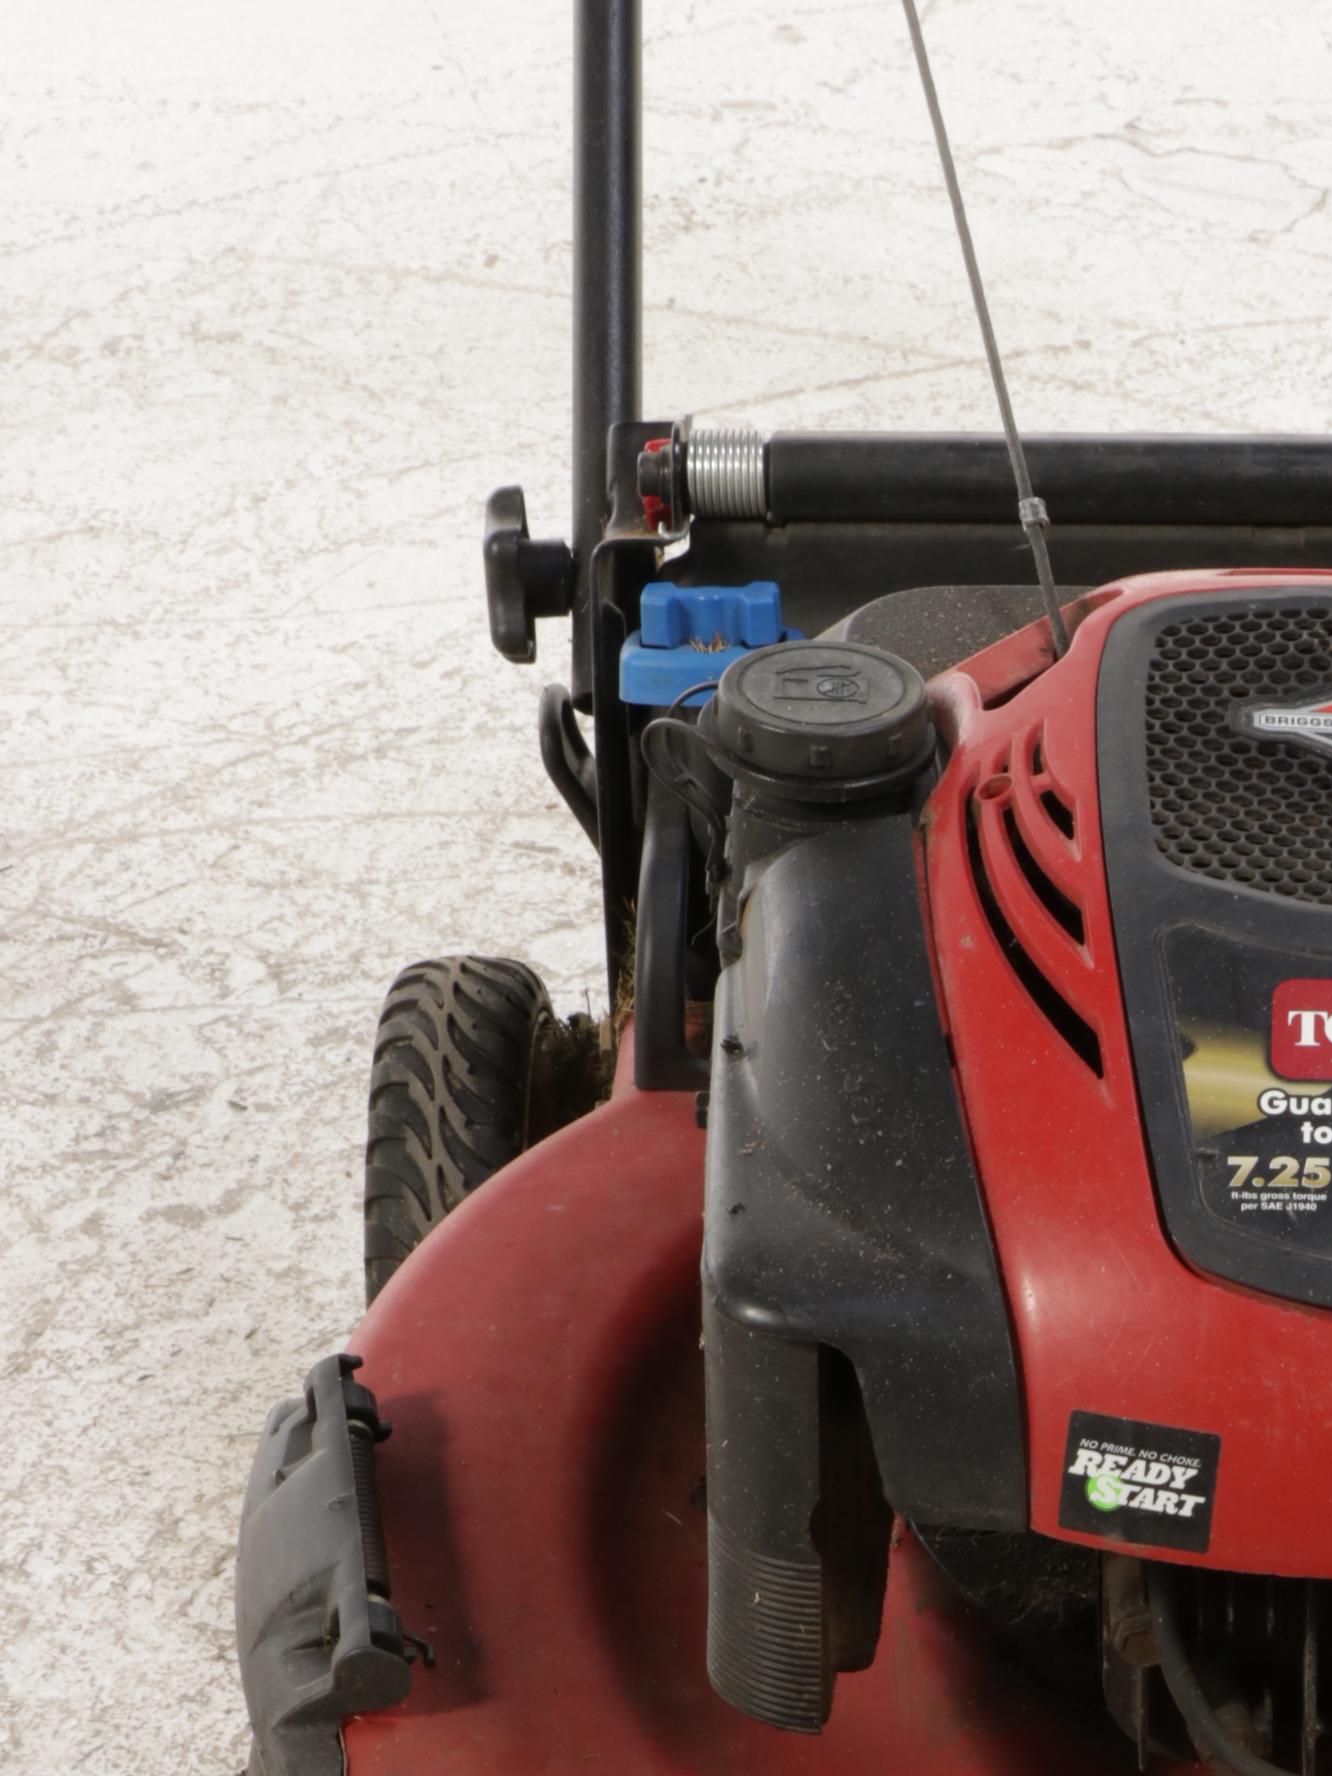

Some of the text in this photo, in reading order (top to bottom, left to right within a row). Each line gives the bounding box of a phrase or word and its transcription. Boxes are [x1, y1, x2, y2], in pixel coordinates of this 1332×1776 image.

[1227, 1156, 1332, 1189] 7.25
[1240, 1203, 1259, 1212] per
[1260, 1202, 1284, 1211] SAE
[1260, 1193, 1290, 1203] gross
[1292, 1192, 1328, 1202] torque
[1079, 1438, 1099, 1450] NO
[1138, 1449, 1157, 1461] NO
[1067, 1448, 1199, 1490] READY
[1088, 1474, 1206, 1518] START
